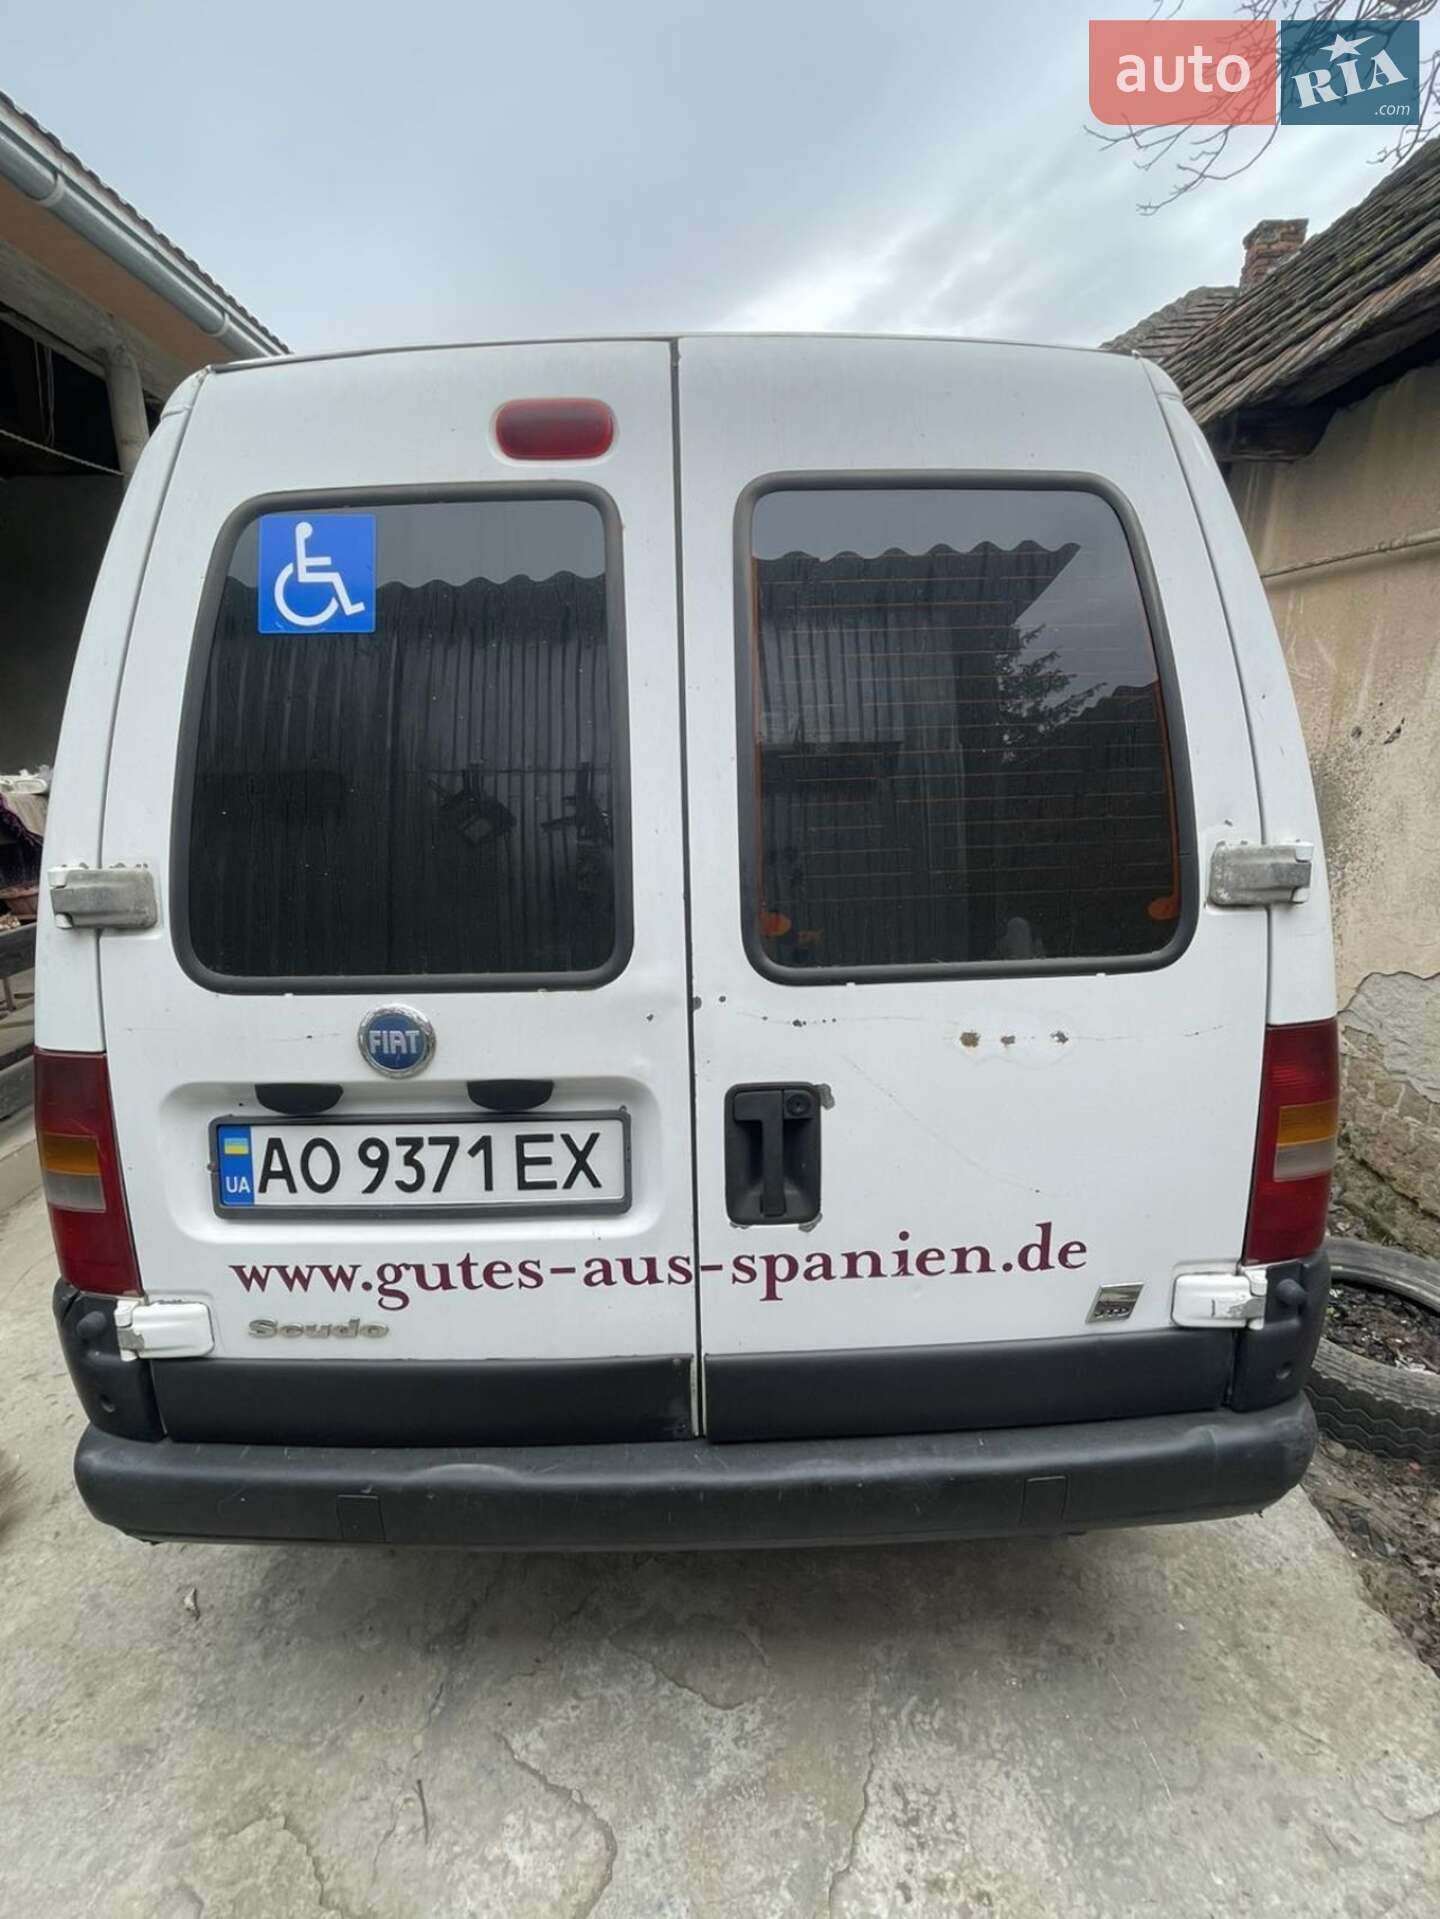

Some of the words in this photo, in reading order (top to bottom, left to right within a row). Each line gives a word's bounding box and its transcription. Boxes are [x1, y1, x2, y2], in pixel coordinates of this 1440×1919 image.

[368, 1030, 420, 1054] FIAT
[226, 1177, 250, 1193] UA
[358, 1135, 494, 1194] 9371
[229, 1222, 1088, 1311] www.gutes-aus-spanien.de
